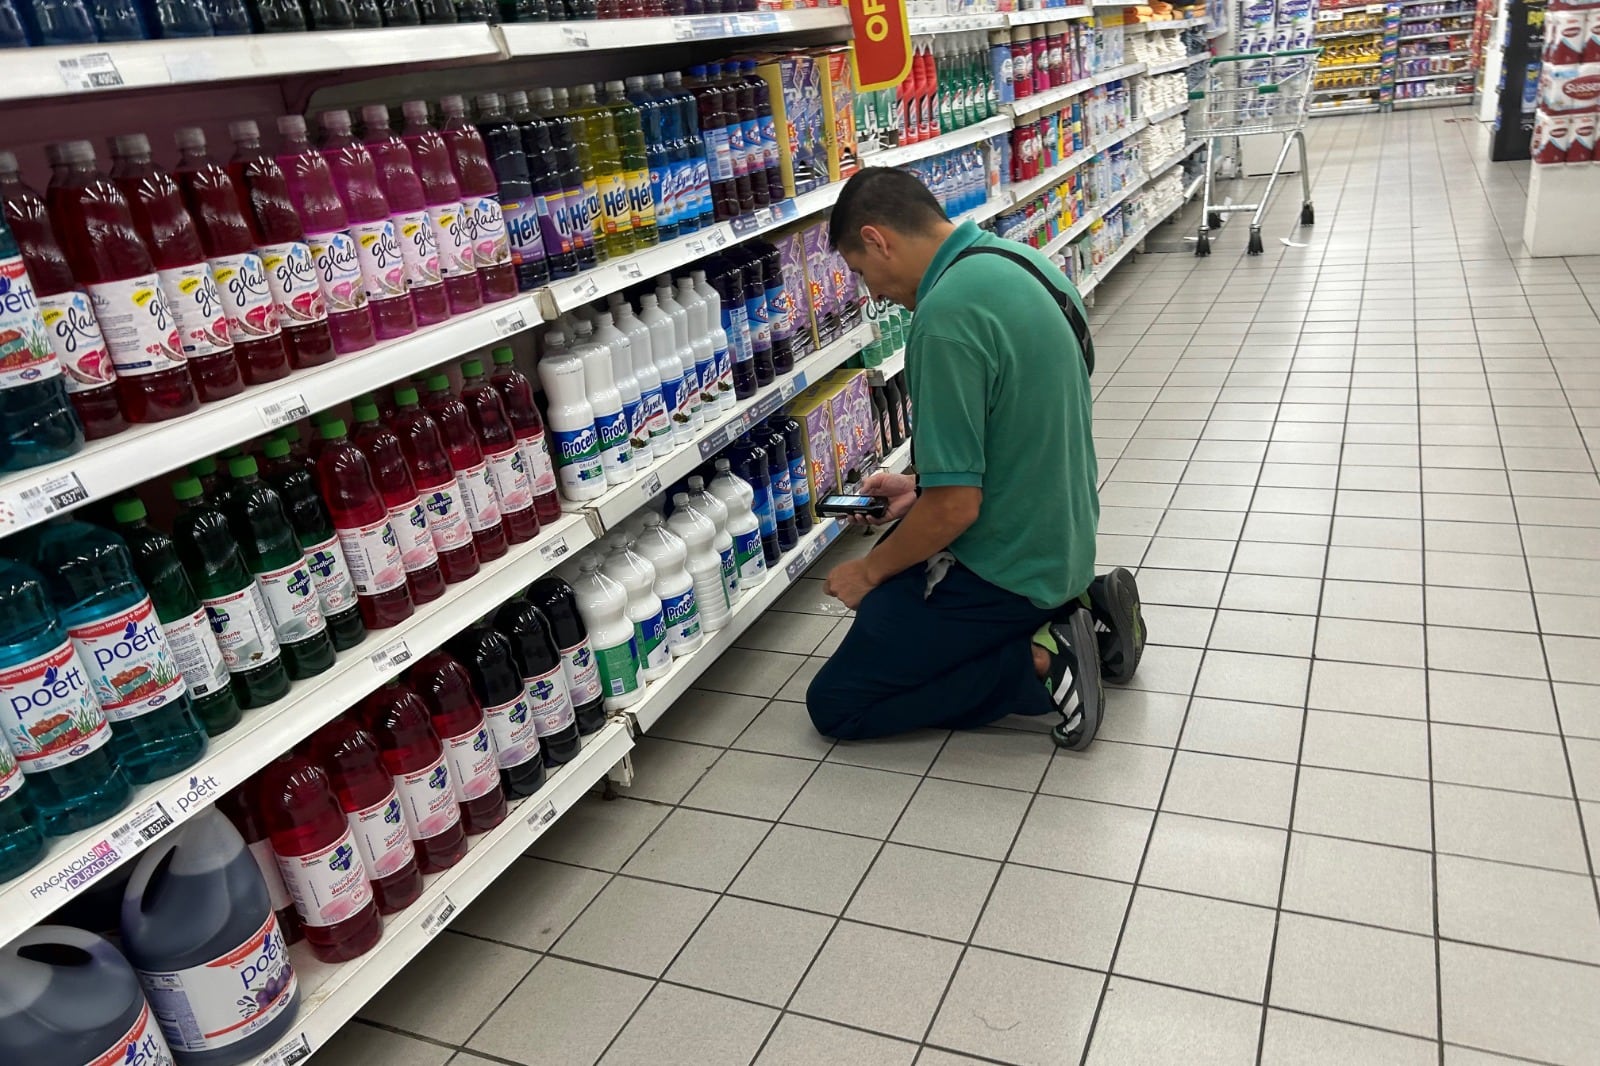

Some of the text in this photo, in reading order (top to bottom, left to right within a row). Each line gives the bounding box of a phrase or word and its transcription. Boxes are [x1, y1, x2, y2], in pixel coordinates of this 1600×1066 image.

[94, 622, 161, 672] poett
[10, 666, 84, 721] poett
[177, 776, 218, 812] poett
[30, 851, 97, 899] FRAGANCIAS
[240, 928, 284, 990] poett
